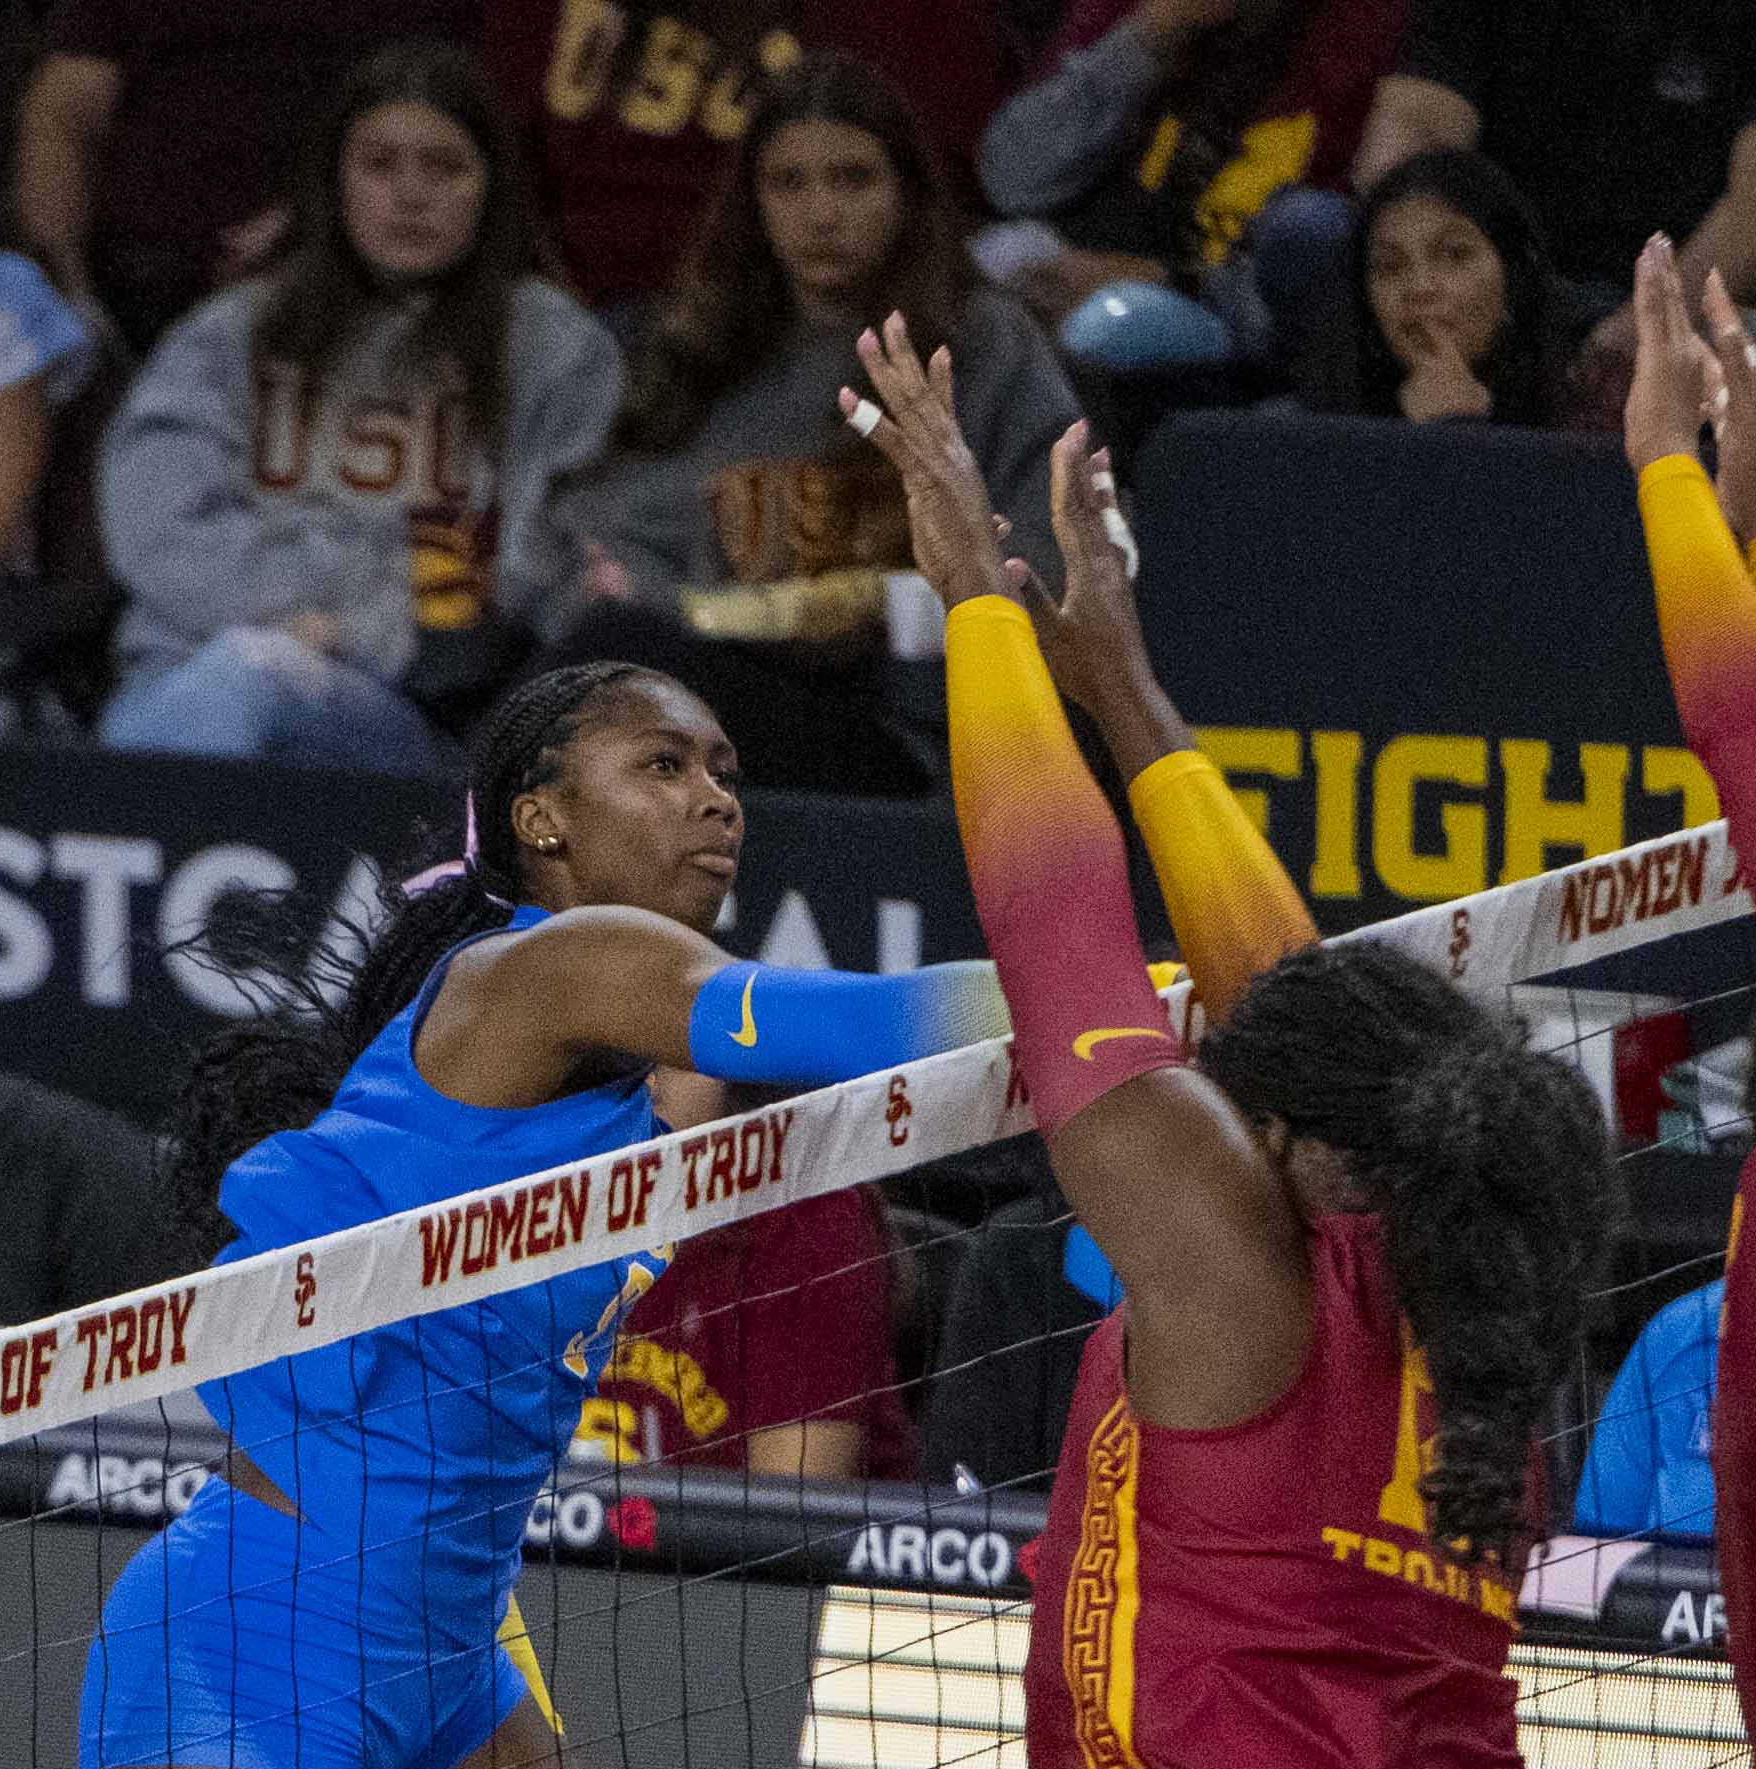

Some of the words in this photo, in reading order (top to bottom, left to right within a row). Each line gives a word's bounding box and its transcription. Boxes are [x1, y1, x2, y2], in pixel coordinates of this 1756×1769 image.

[420, 1172, 586, 1289] WOMEN
[607, 1152, 662, 1233] OF
[681, 1110, 794, 1209] TROY
[0, 1330, 58, 1416] OF
[77, 1291, 195, 1393] TROY
[848, 1524, 1007, 1585] ARCO
